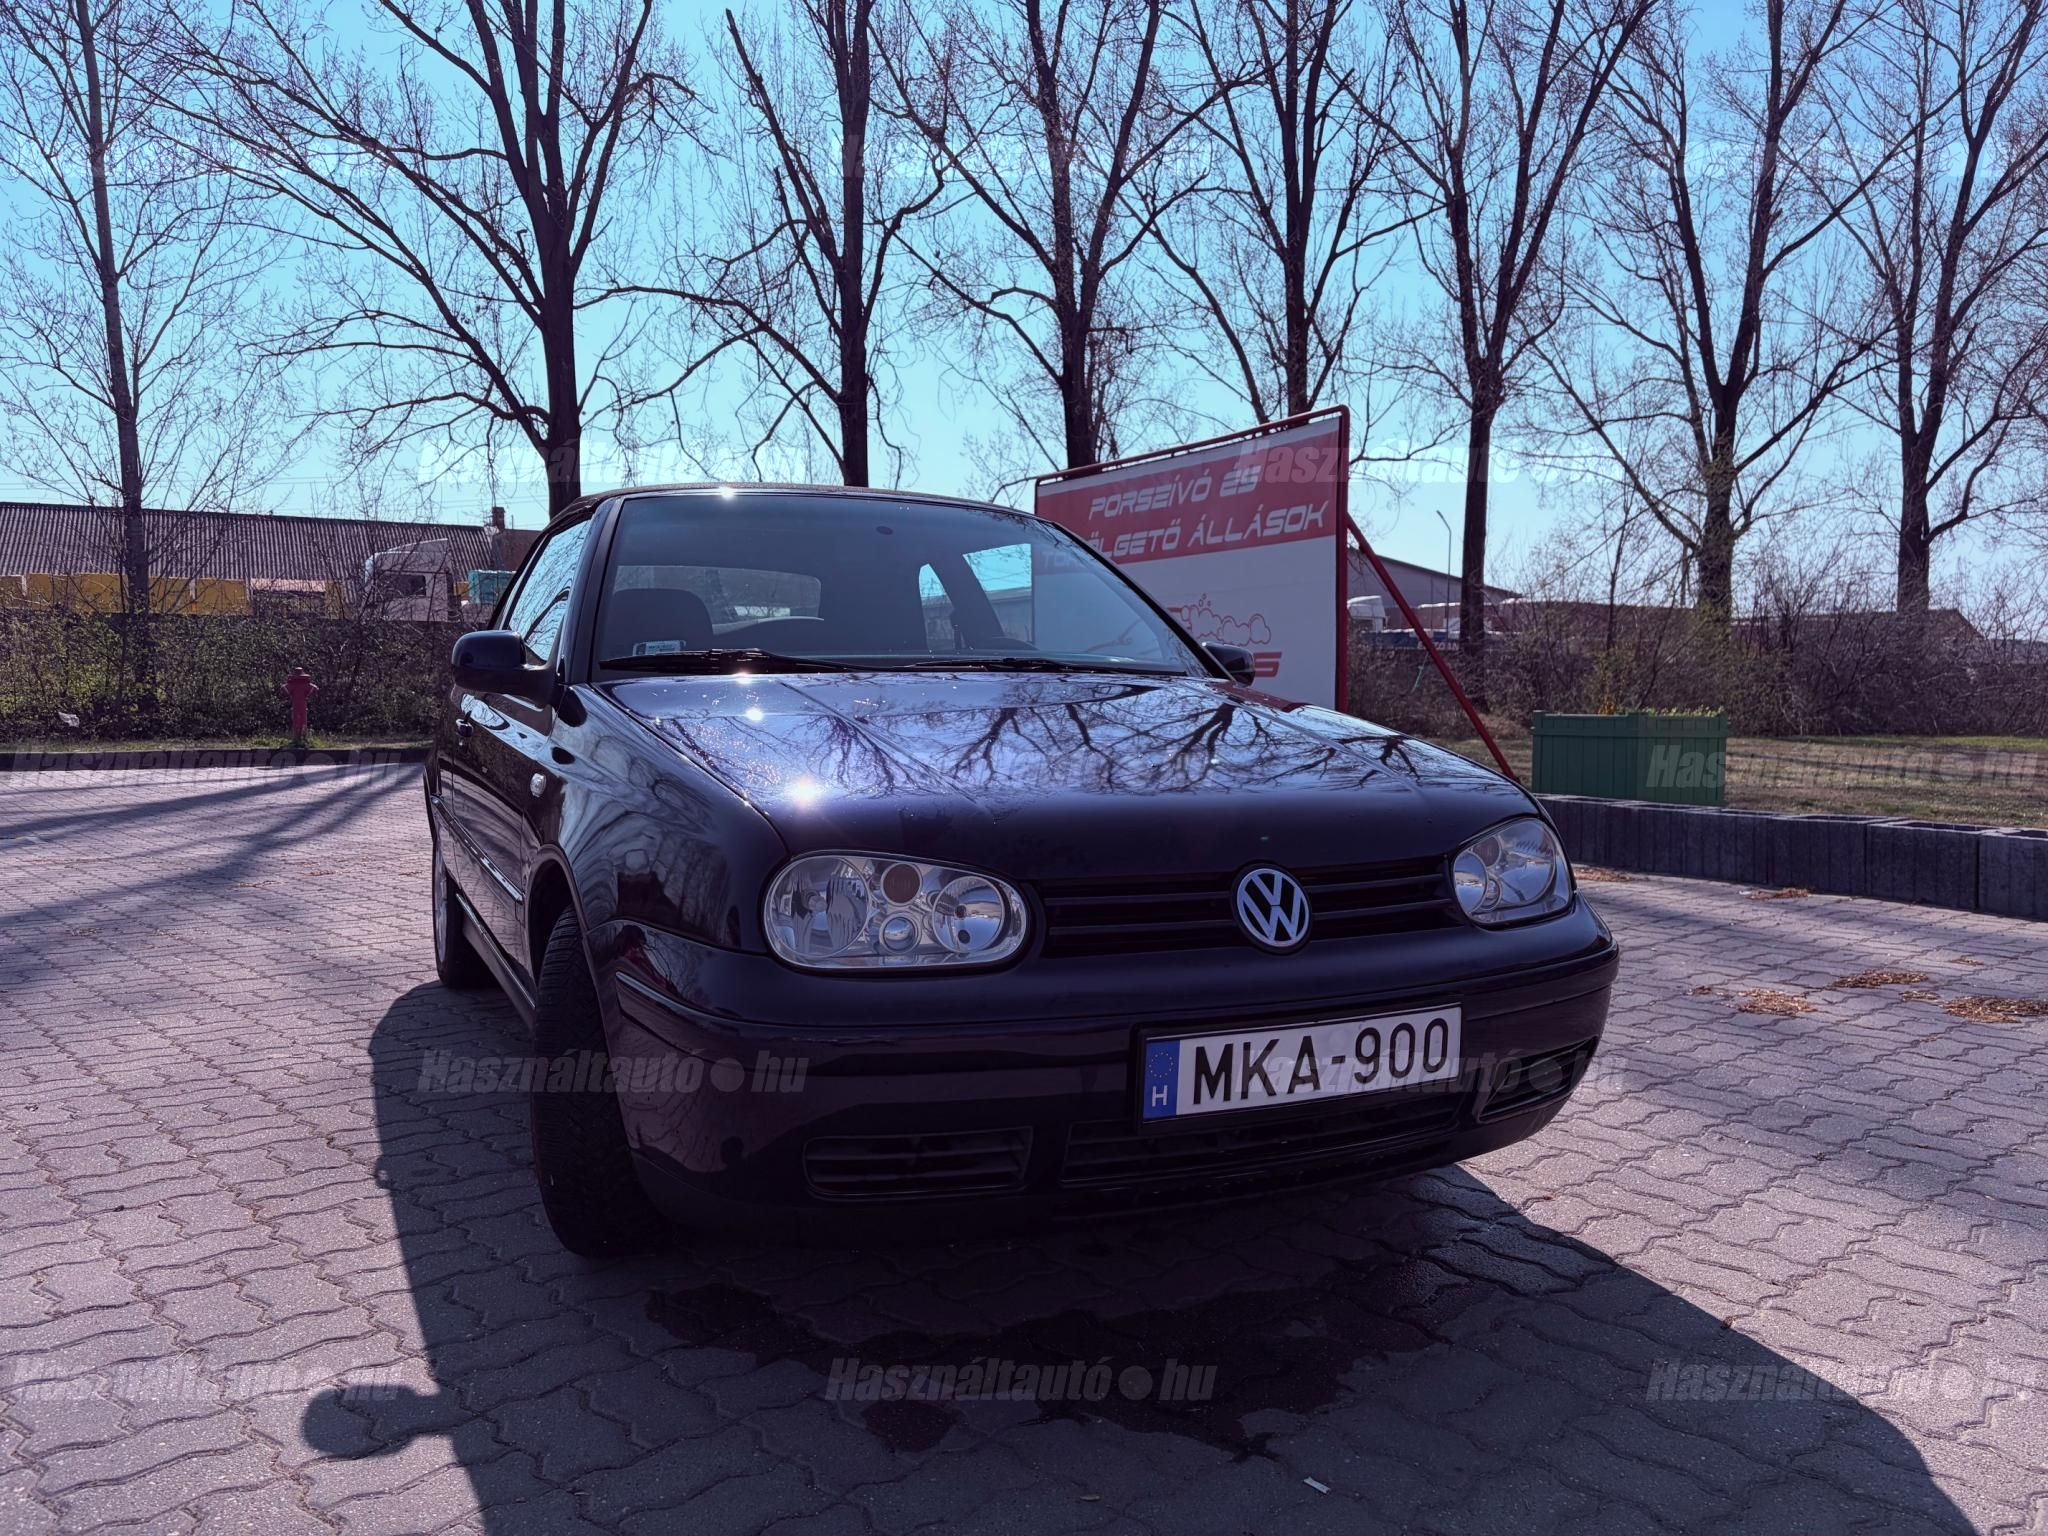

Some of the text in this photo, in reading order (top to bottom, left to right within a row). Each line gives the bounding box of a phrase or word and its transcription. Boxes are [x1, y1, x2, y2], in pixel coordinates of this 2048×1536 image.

[1088, 462, 1262, 520] PORSEÍVÓ ÉS
[1187, 501, 1328, 547] ÁLLÁSOK
[1193, 1018, 1448, 1105] MKA-900
[1151, 1085, 1168, 1107] H
